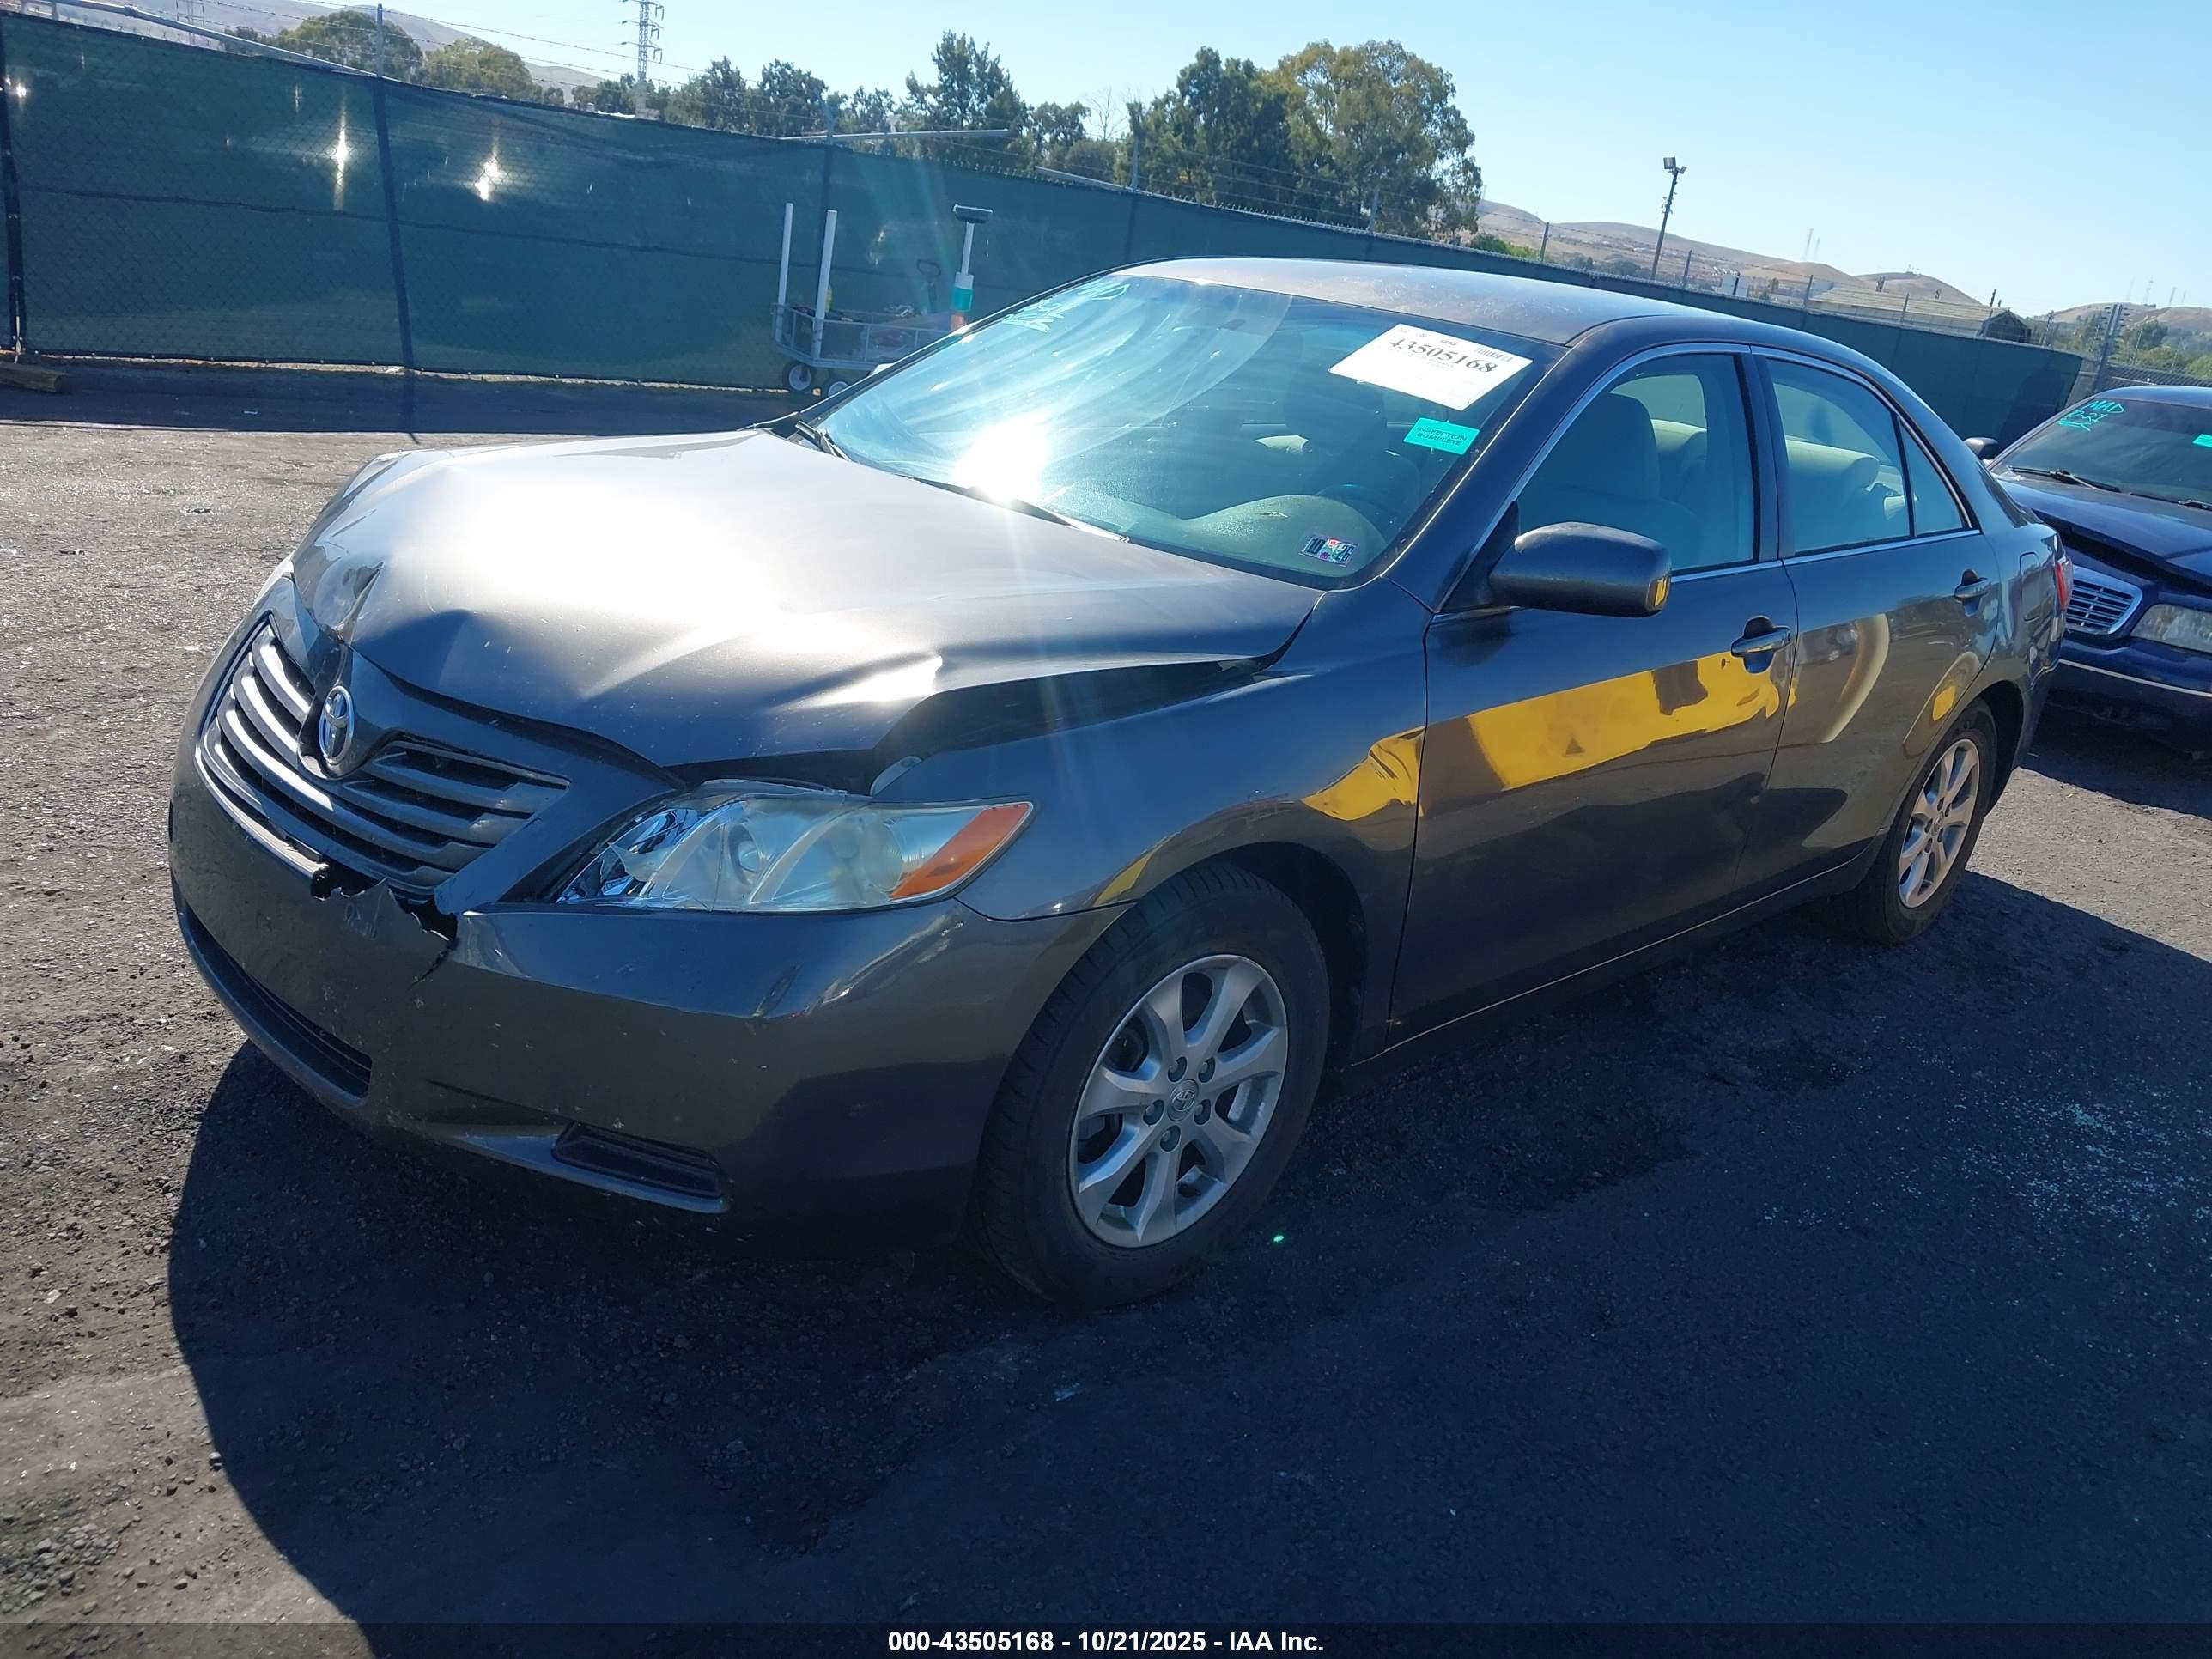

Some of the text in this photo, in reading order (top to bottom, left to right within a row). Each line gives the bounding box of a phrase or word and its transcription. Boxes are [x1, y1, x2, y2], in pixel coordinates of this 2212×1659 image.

[1389, 338, 1498, 373] 43505168
[1416, 426, 1468, 441] INSPECTION
[1416, 432, 1462, 446] COMPLETE
